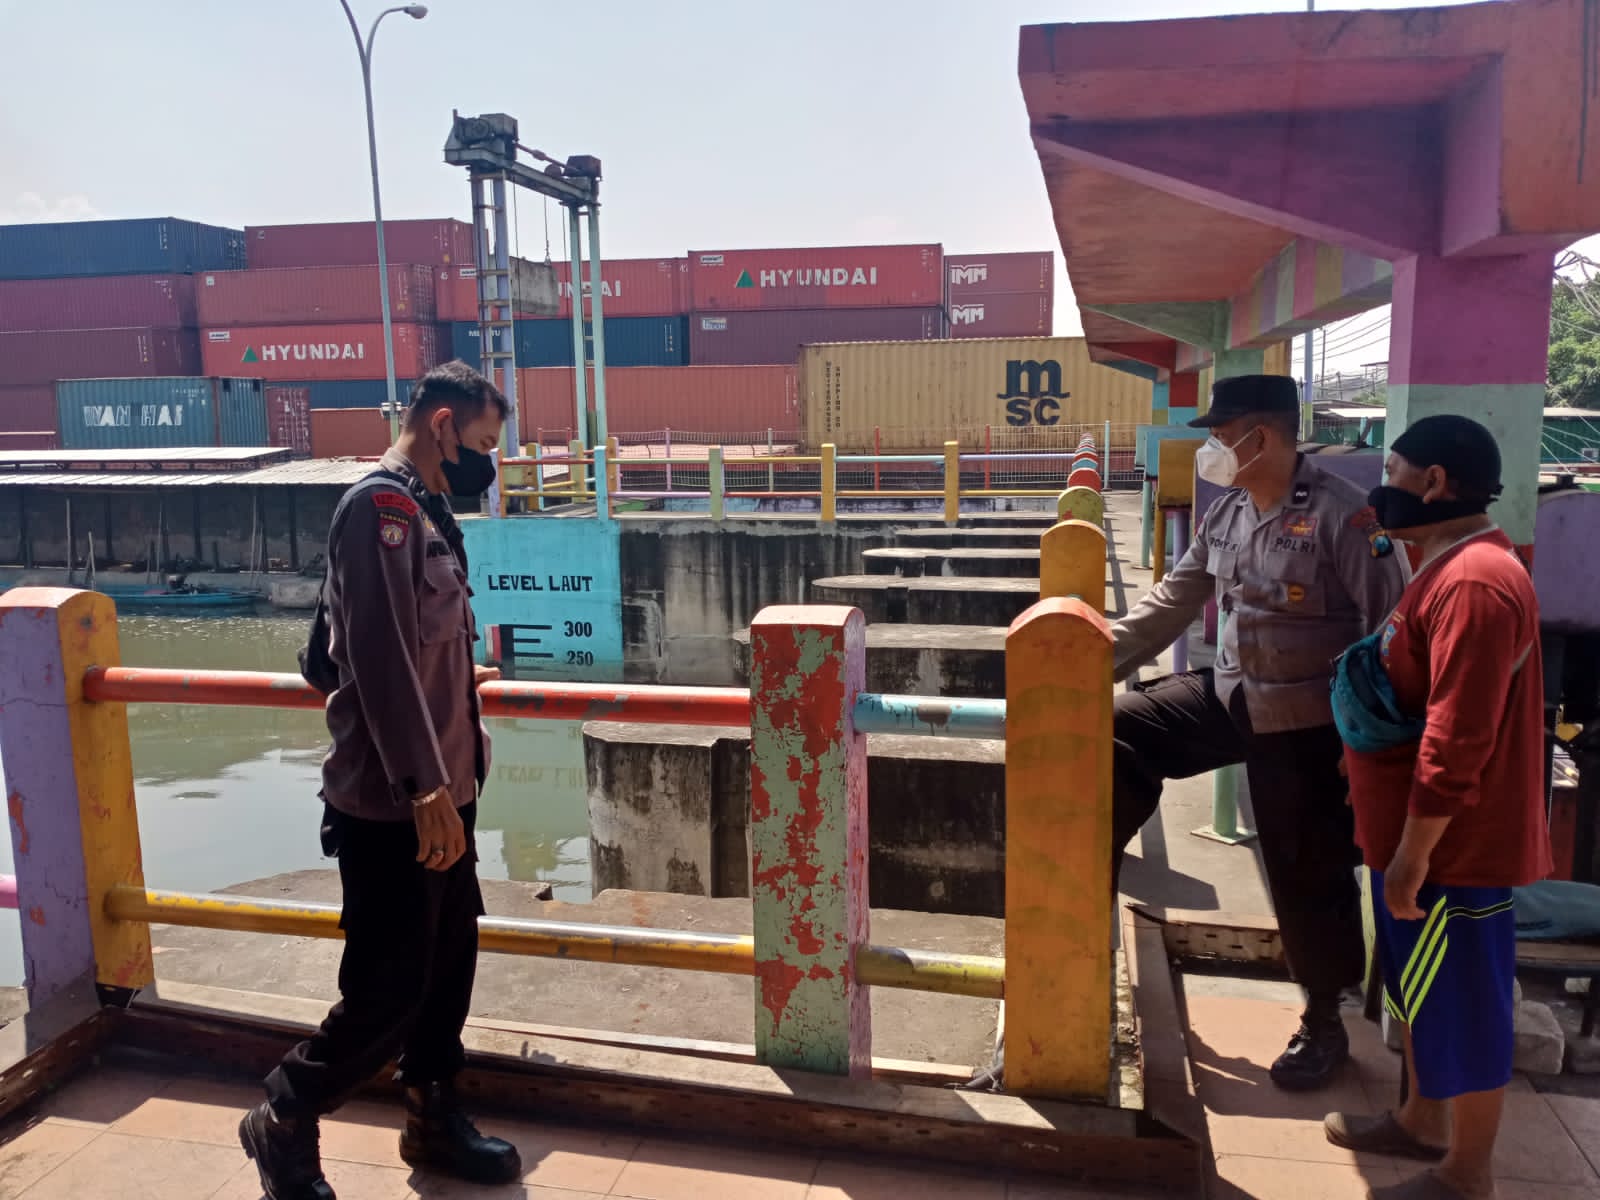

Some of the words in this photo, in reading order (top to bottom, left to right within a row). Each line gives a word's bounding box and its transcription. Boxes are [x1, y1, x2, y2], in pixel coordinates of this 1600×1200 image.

[760, 267, 877, 288] HYUNDAI
[262, 343, 364, 361] HYUNDAI
[83, 404, 131, 427] WAN
[140, 404, 183, 427] HAI
[1273, 536, 1317, 553] POLRI
[488, 574, 543, 591] LEVEL
[549, 575, 593, 592] LAUT
[564, 620, 593, 638] 300
[566, 650, 594, 667] 250
